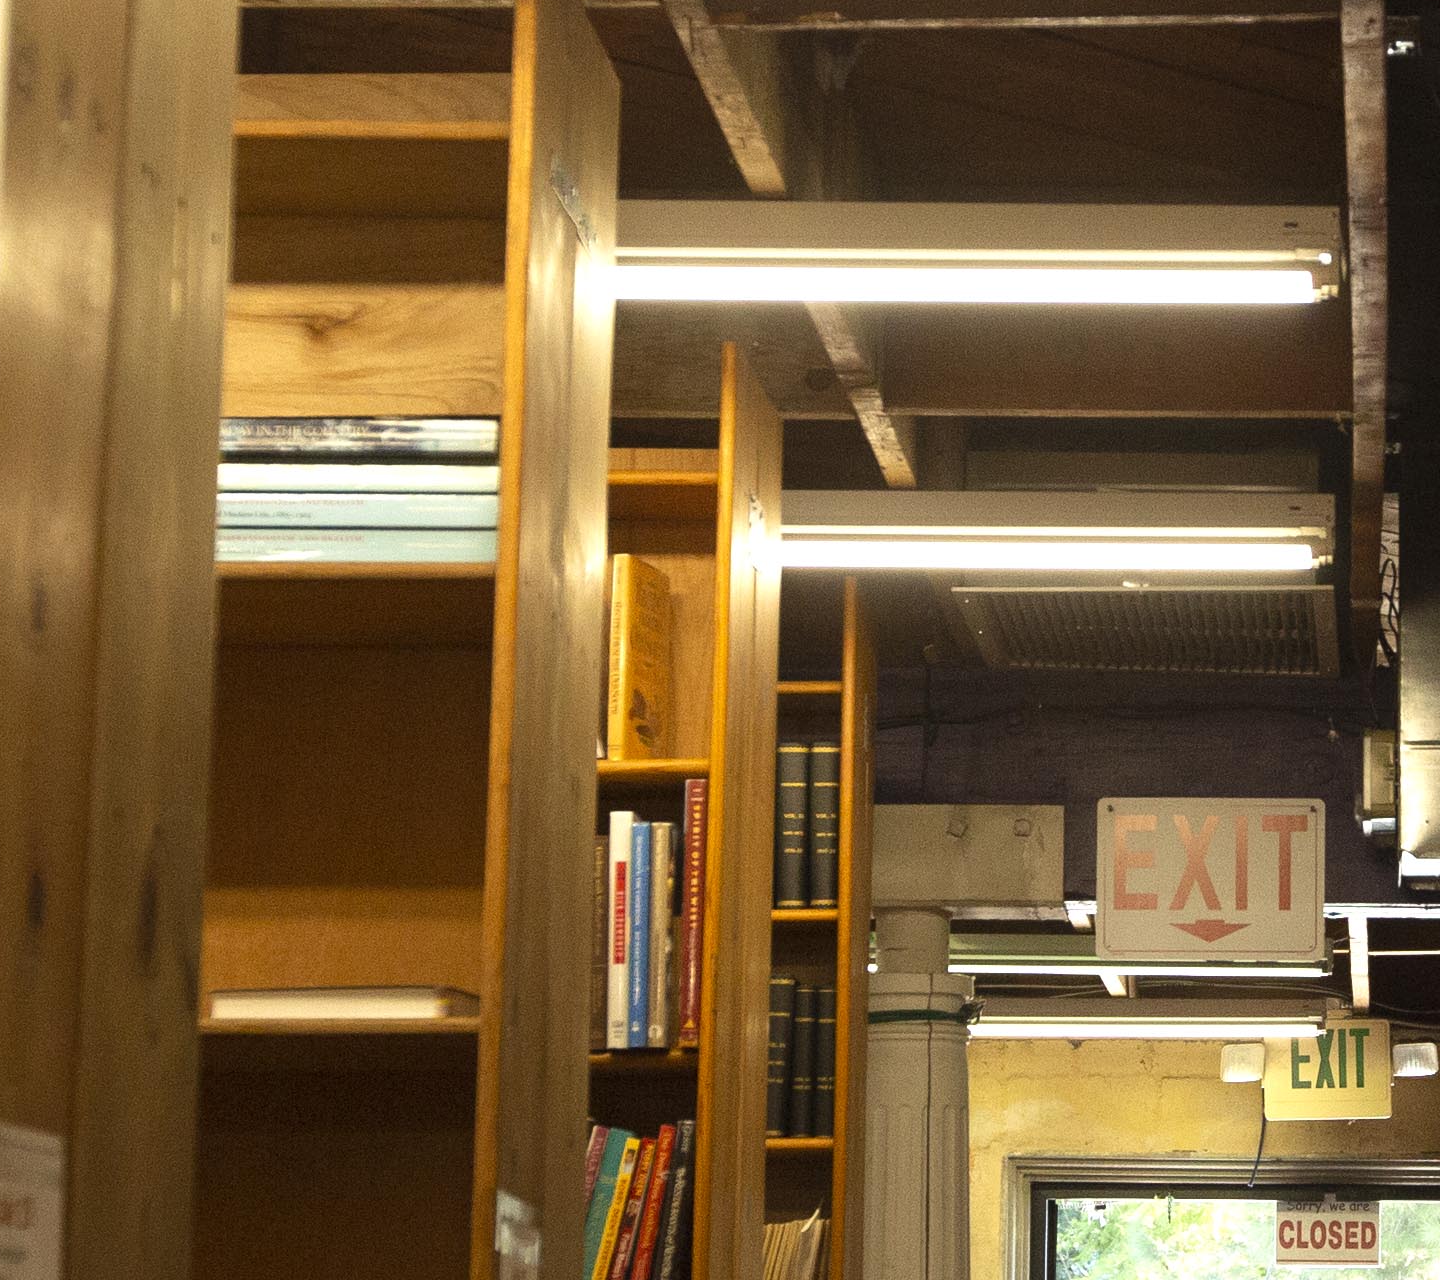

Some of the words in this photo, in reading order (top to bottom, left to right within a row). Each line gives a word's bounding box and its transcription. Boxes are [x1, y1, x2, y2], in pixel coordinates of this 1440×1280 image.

[692, 804, 702, 847] SPIRIT
[691, 851, 701, 867] OF
[1113, 814, 1309, 912] EXIT
[690, 870, 700, 893] THE
[689, 896, 699, 929] WEST
[1291, 1027, 1370, 1090] EXIT
[613, 1179, 628, 1205] BOBBY
[1286, 1201, 1326, 1213] Sorry,
[1330, 1203, 1346, 1212] we
[1349, 1202, 1371, 1212] are
[1279, 1220, 1377, 1250] CLOSED
